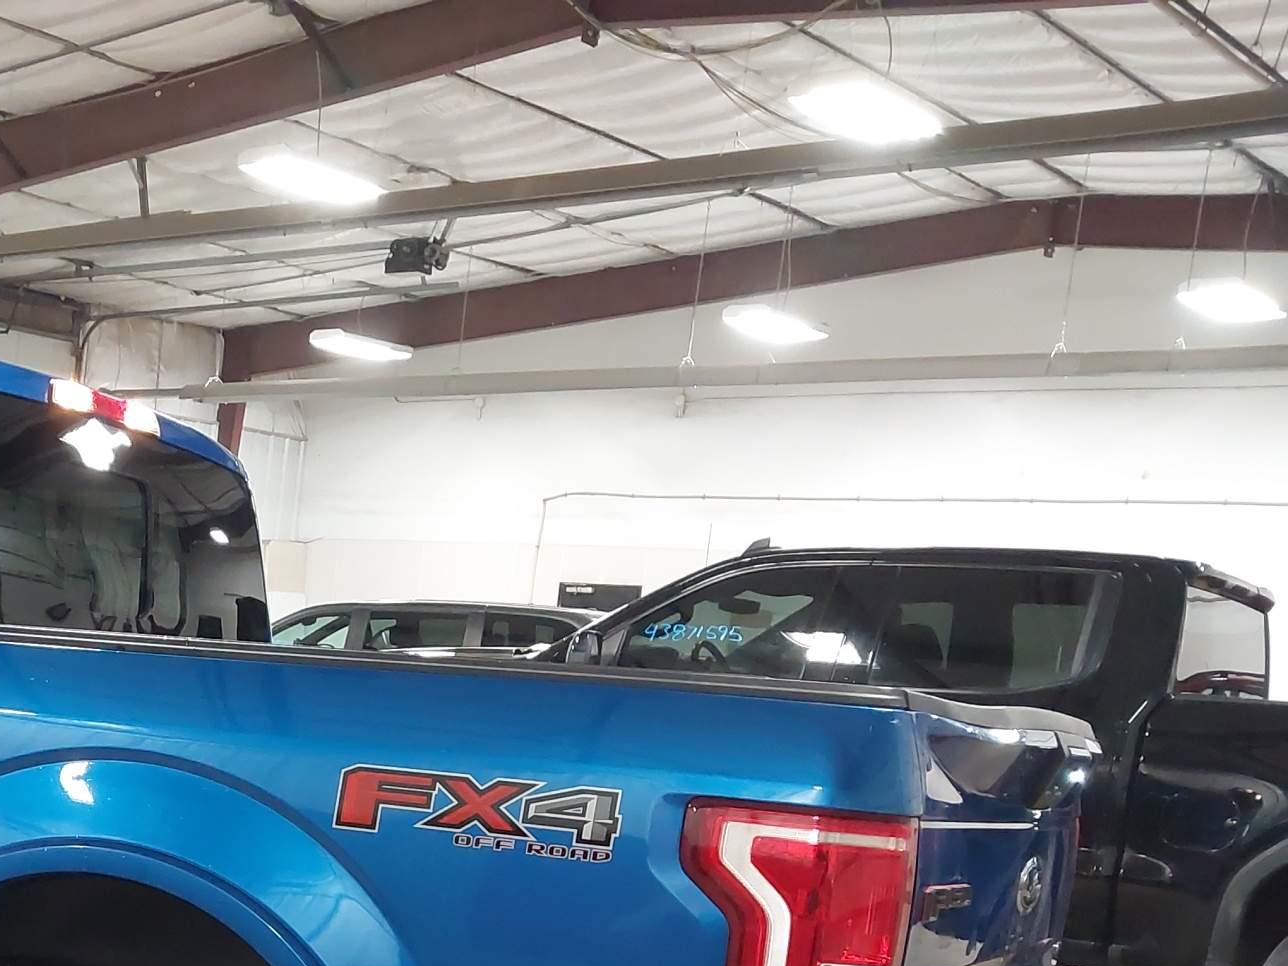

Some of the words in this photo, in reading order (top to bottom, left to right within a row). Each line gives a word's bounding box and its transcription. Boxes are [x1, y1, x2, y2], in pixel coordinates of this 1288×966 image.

[332, 764, 622, 850] FX4
[453, 833, 515, 852] OFF
[525, 841, 613, 864] ROAD
